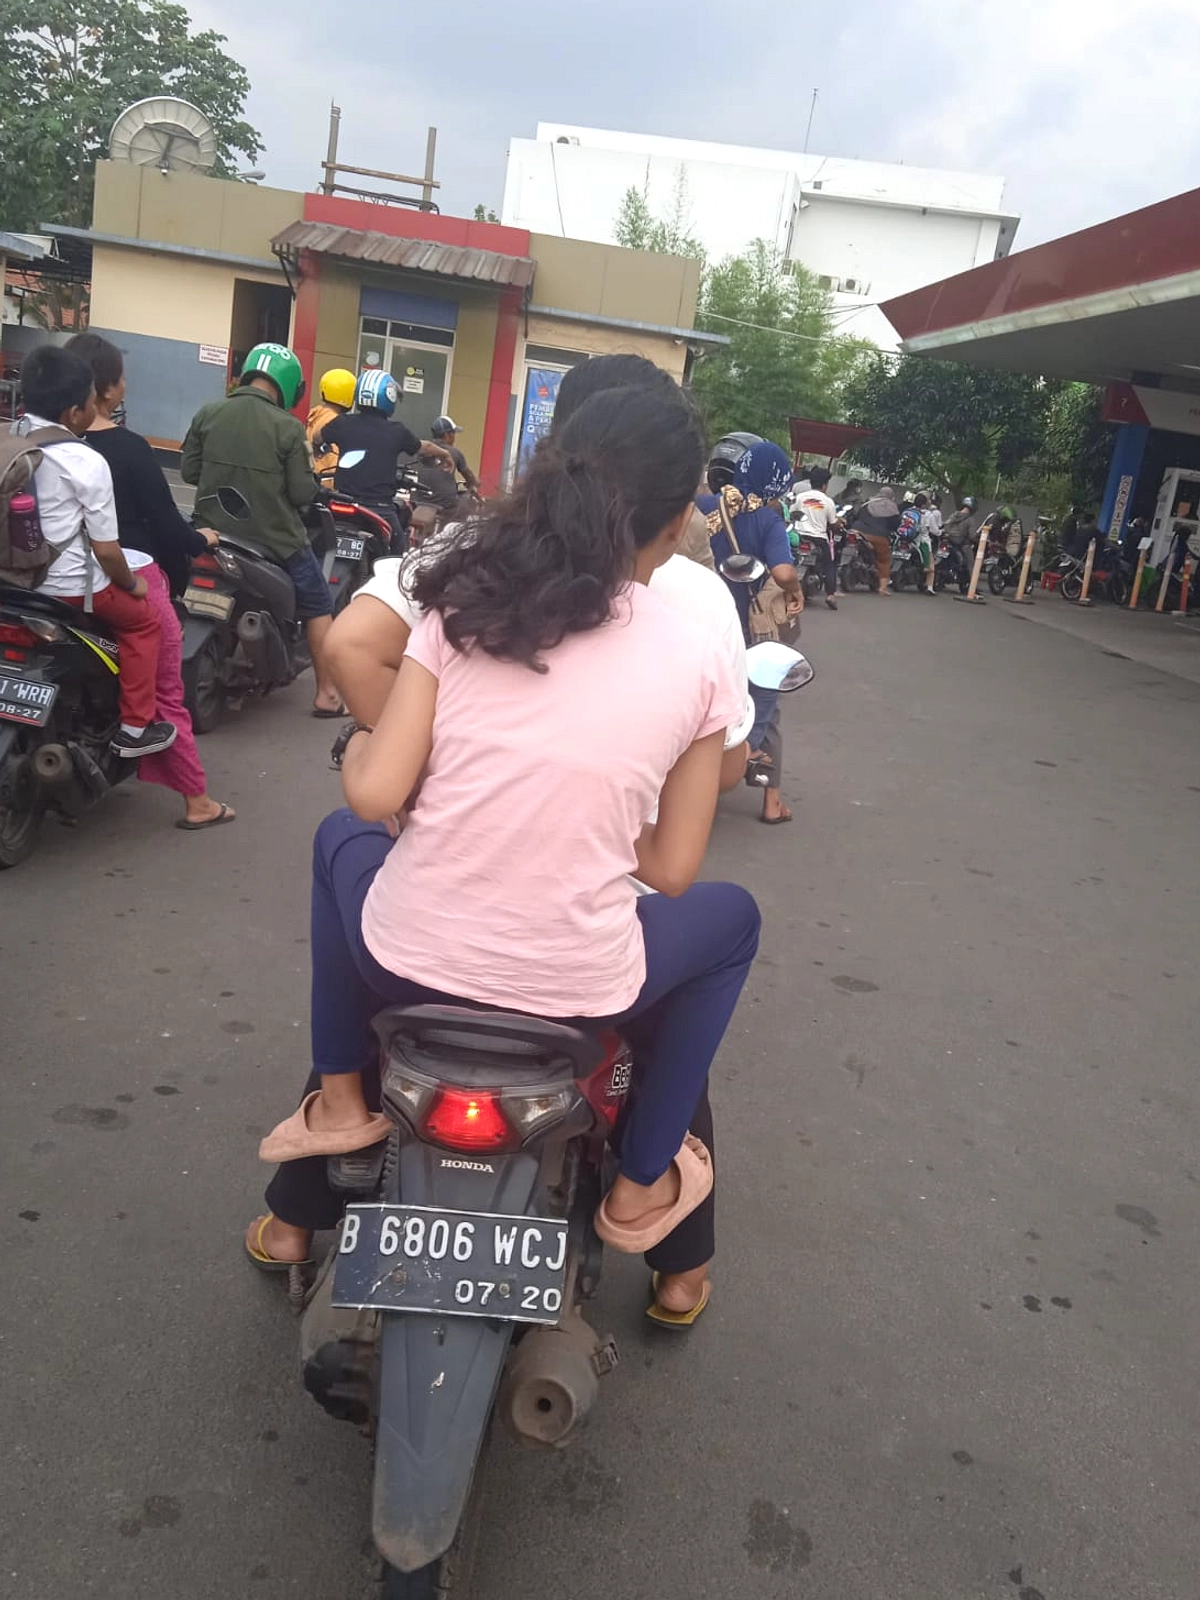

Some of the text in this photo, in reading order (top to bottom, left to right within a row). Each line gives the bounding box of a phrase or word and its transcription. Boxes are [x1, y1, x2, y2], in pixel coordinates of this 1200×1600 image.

[440, 1159, 495, 1174] HONDA
[339, 1214, 567, 1271] B 6806 WCJ
[455, 1280, 562, 1312] 07 20
